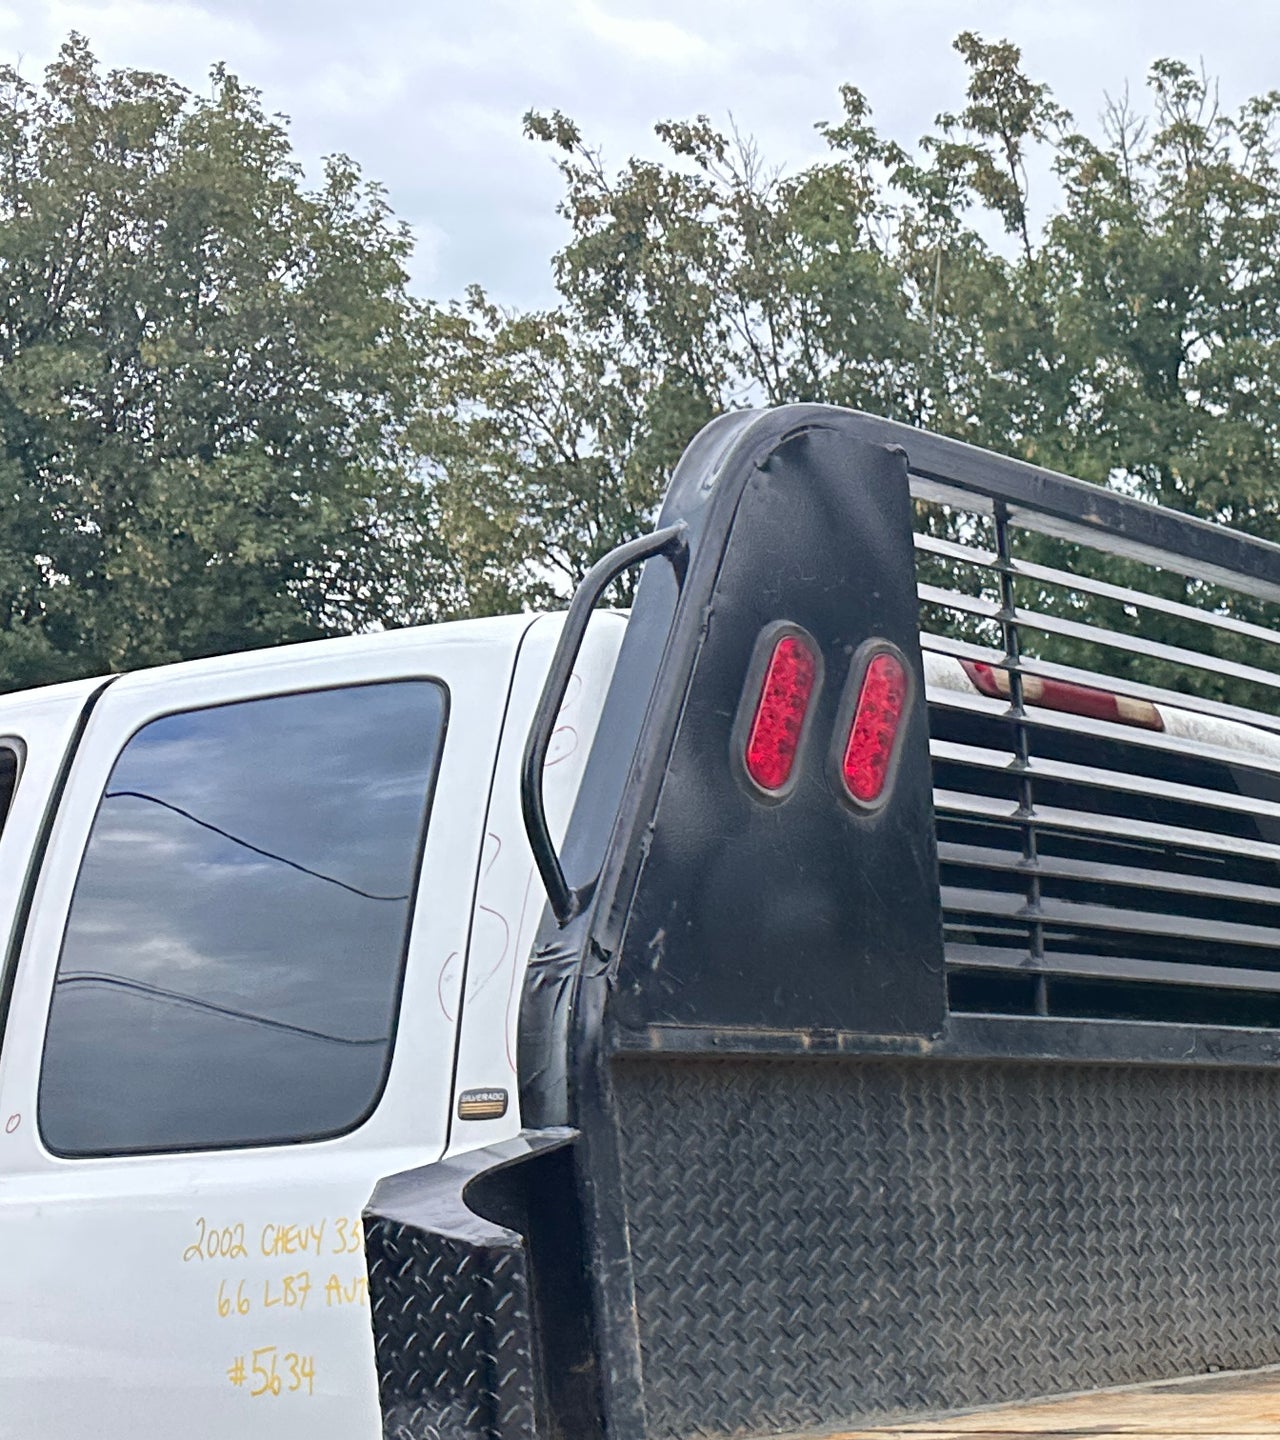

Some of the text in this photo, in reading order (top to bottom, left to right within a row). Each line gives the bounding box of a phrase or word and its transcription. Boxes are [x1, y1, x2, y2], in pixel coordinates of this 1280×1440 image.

[460, 1092, 505, 1103] SILVERADO
[183, 1216, 249, 1262] 2002
[260, 1217, 327, 1257] CHEVY
[263, 1271, 312, 1311] LB7
[226, 1344, 316, 1397] #5634
